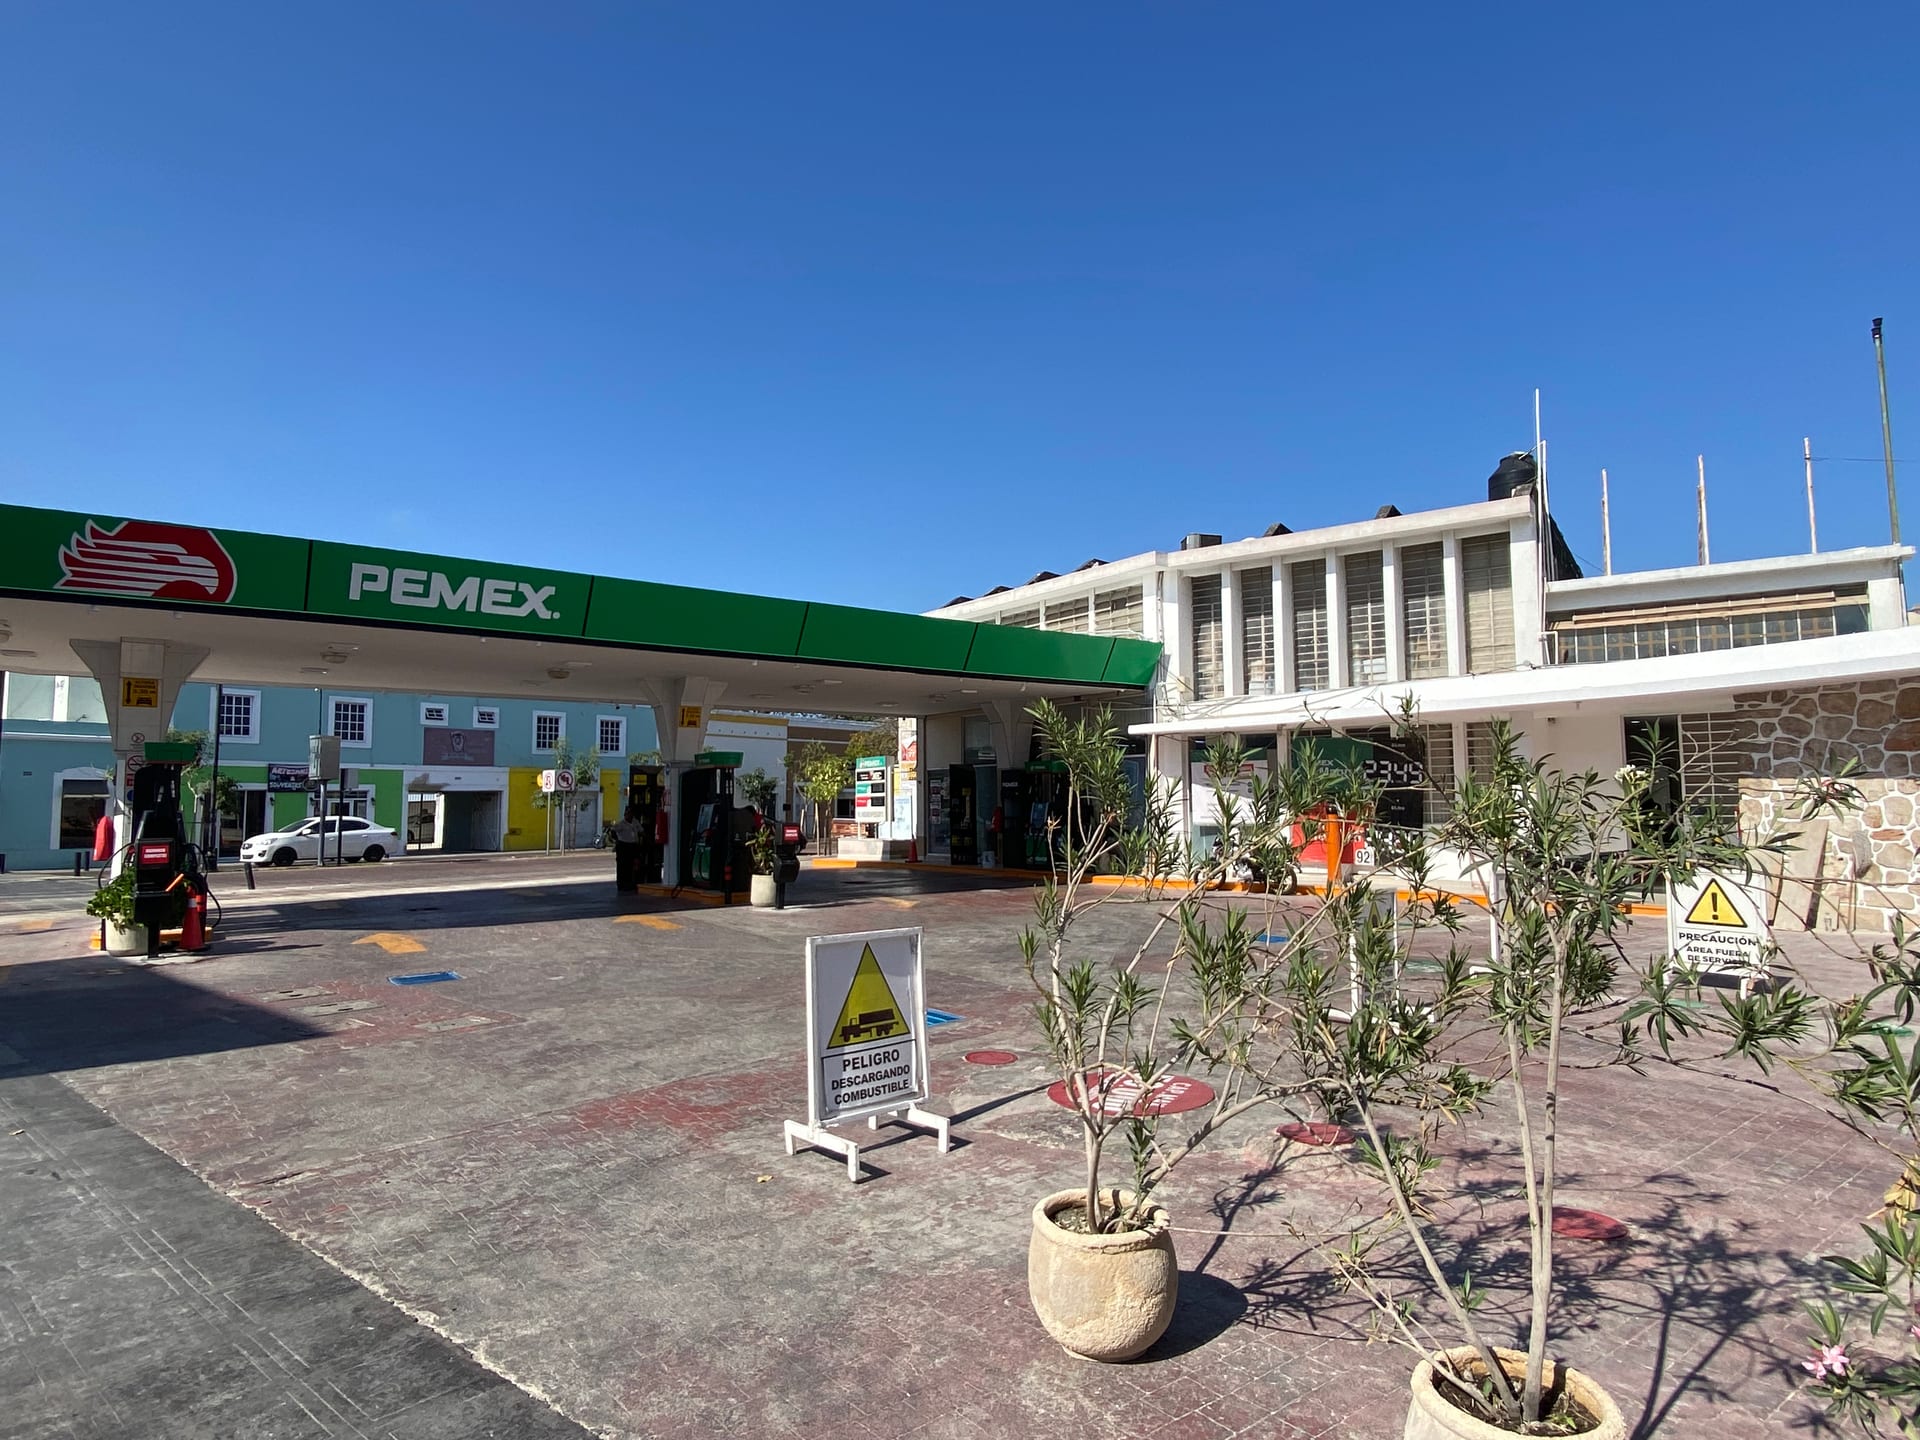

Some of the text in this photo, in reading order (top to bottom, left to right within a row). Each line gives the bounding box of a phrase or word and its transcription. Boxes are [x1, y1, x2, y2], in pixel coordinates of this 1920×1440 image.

[1356, 850, 1371, 863] 92
[1679, 931, 1756, 946] PRECAUCIÓN
[1687, 954, 1700, 962] DE
[842, 1049, 900, 1072] PELIGRO
[832, 1064, 910, 1090] DESCARGANDO
[834, 1079, 909, 1105] COMBUSTIBLE
